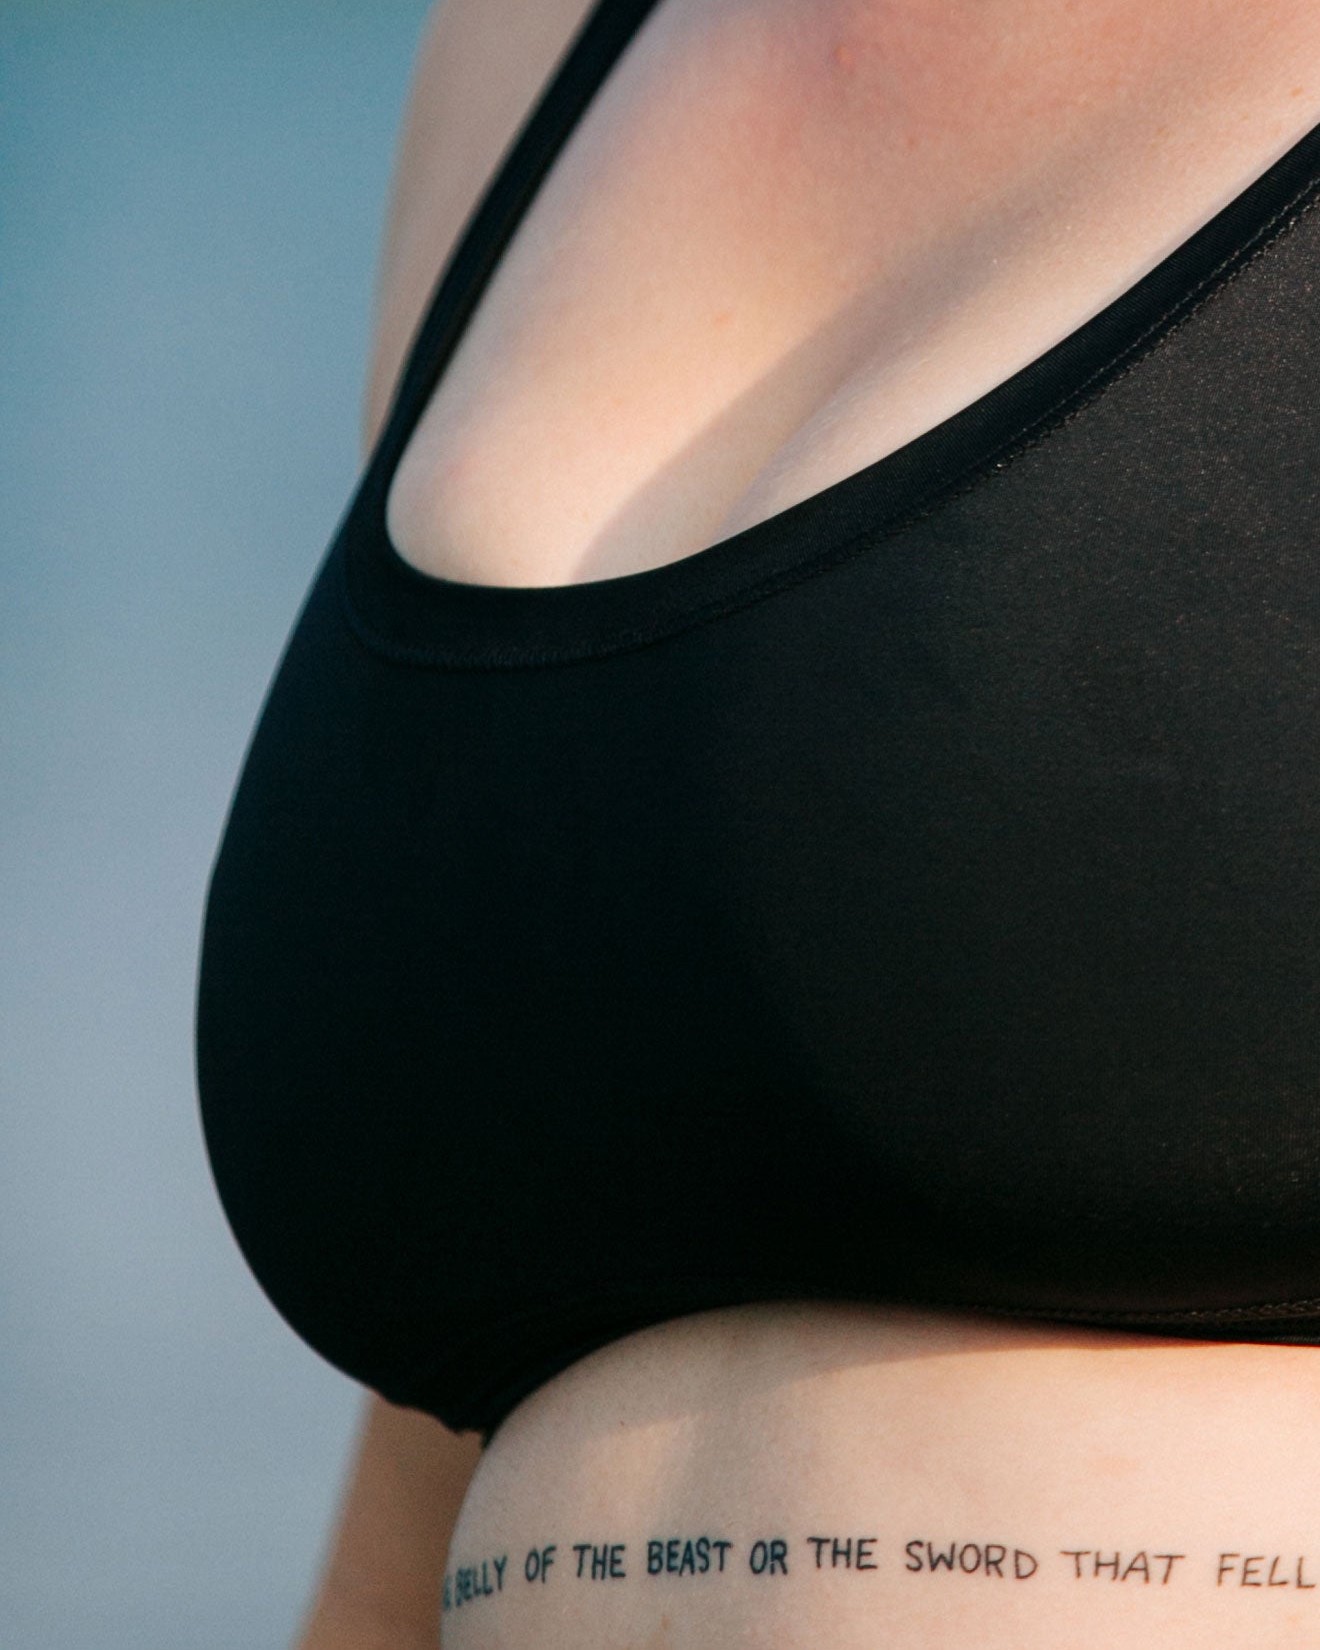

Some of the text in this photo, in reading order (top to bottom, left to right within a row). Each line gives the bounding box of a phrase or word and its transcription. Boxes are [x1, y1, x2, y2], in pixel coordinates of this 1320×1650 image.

[524, 1545, 557, 1584] OF
[572, 1543, 627, 1580] THE
[647, 1537, 732, 1577] BEAST
[749, 1539, 788, 1575] OR
[807, 1536, 878, 1572] THE
[905, 1539, 1039, 1580] SWORD
[1060, 1550, 1185, 1585] THAT
